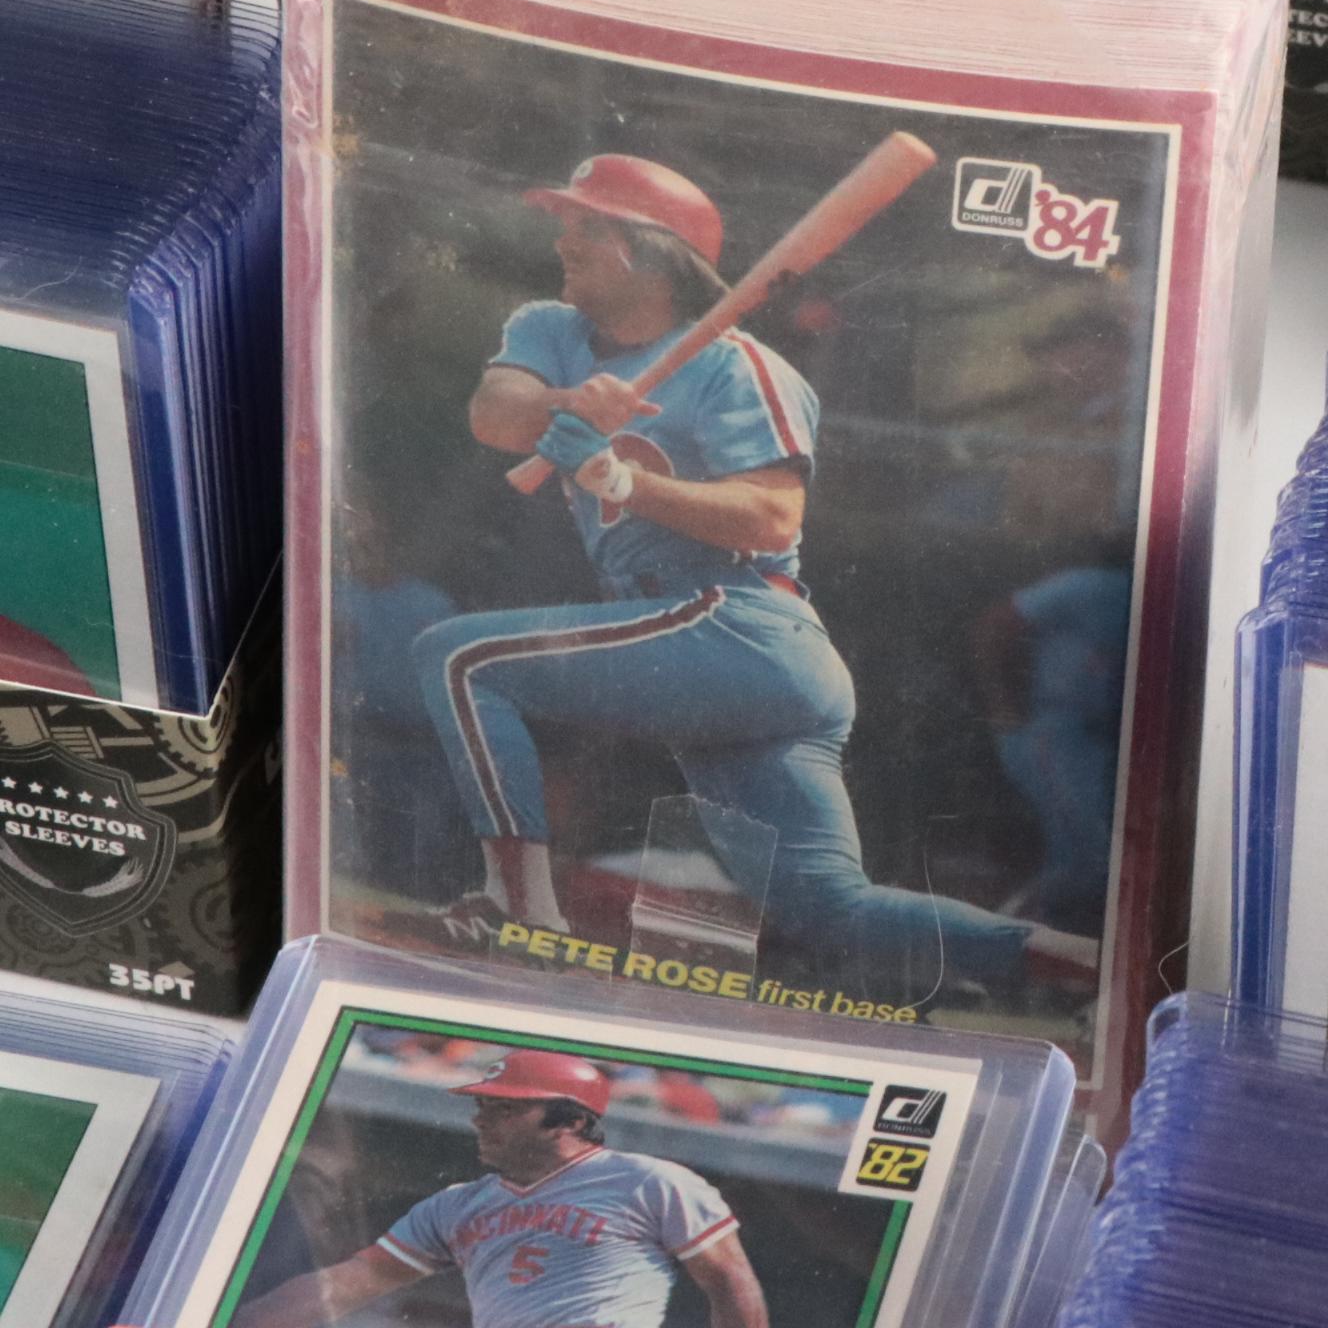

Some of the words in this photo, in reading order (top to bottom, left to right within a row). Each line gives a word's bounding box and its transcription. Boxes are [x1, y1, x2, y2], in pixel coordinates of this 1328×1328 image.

[961, 211, 1024, 228] DONRUSS
[0, 798, 146, 840] ROTECTOR
[5, 821, 126, 856] SLEEVES
[109, 962, 195, 1001] 35PT
[500, 922, 618, 971] PETE
[622, 952, 753, 1000] ROSE
[757, 980, 826, 1014] first
[830, 990, 918, 1025] base
[508, 1245, 551, 1286] 5
